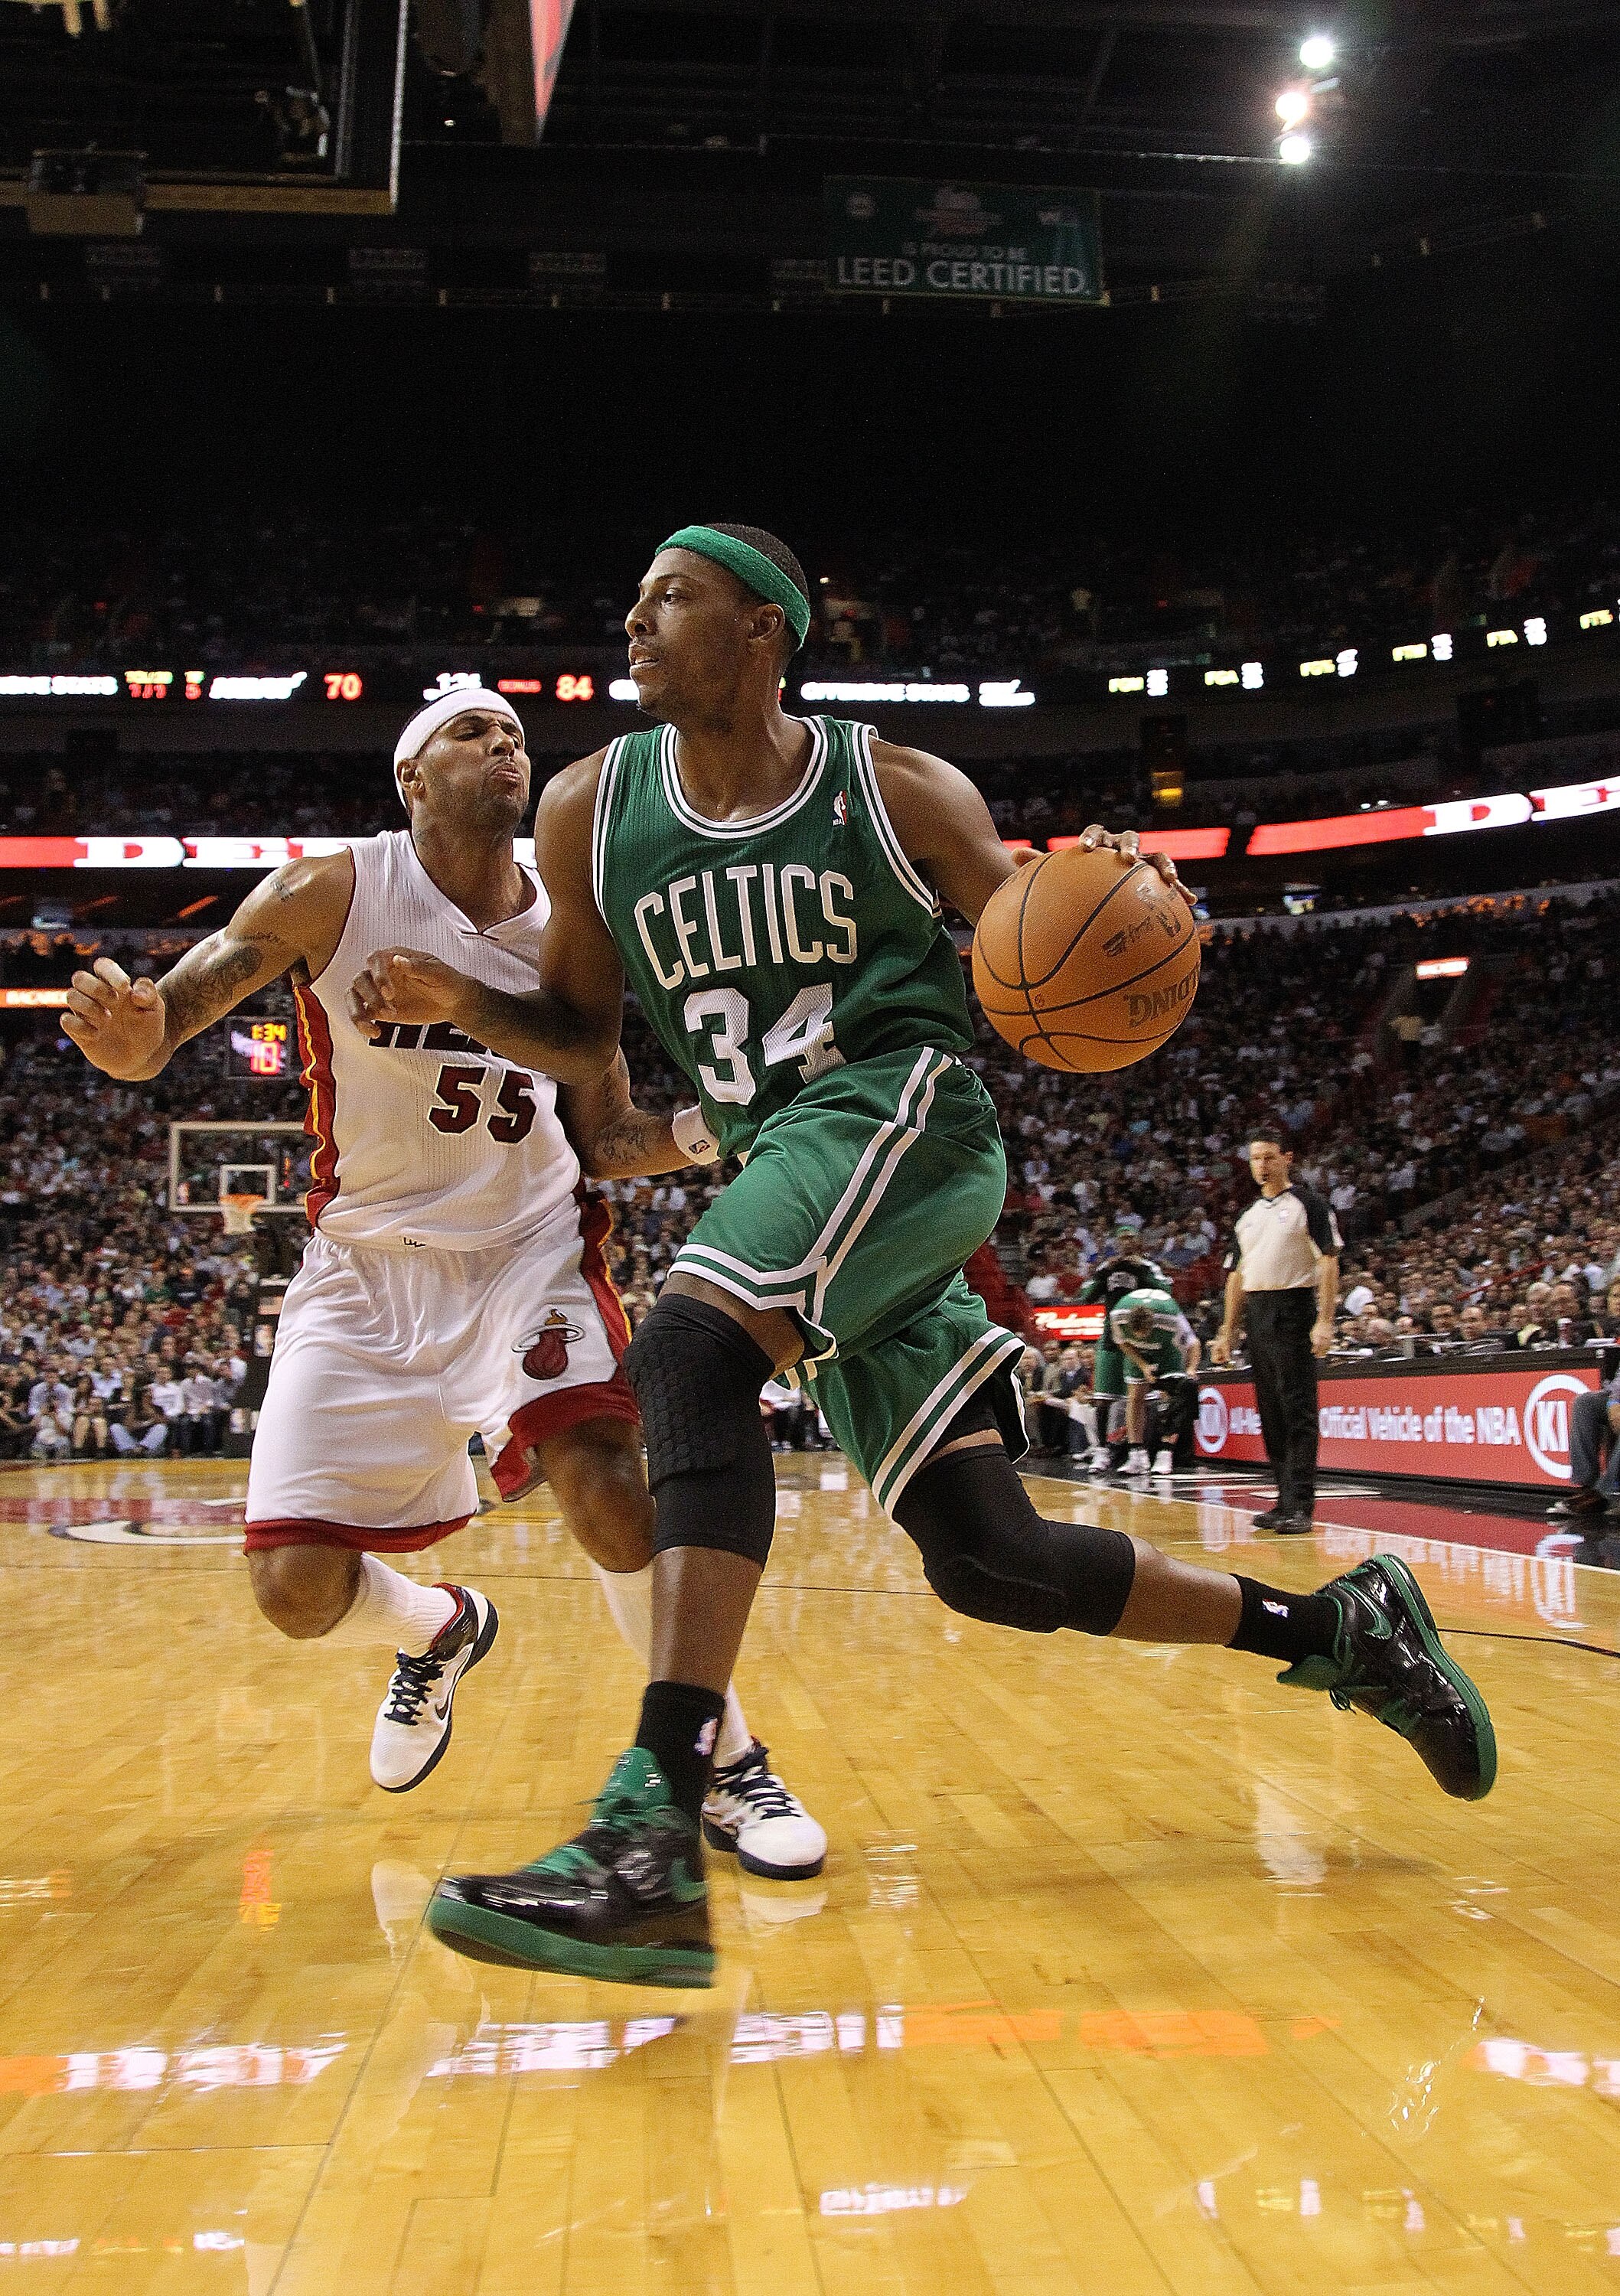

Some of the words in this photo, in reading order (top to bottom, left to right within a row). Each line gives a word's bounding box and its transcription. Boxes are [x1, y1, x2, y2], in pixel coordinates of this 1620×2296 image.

[838, 256, 915, 286] LEED
[324, 673, 363, 700] 70
[556, 673, 594, 701] 84
[634, 863, 857, 990] CELTICS
[251, 1022, 287, 1042] 1:34
[683, 983, 846, 1106] 34
[427, 1063, 538, 1144] 55
[1318, 1406, 1367, 1440] Official
[1367, 1406, 1423, 1441] Vehicle
[1423, 1406, 1443, 1442] of
[1444, 1406, 1475, 1443] the
[1476, 1407, 1522, 1446] NBA
[1535, 1400, 1569, 1452] KI
